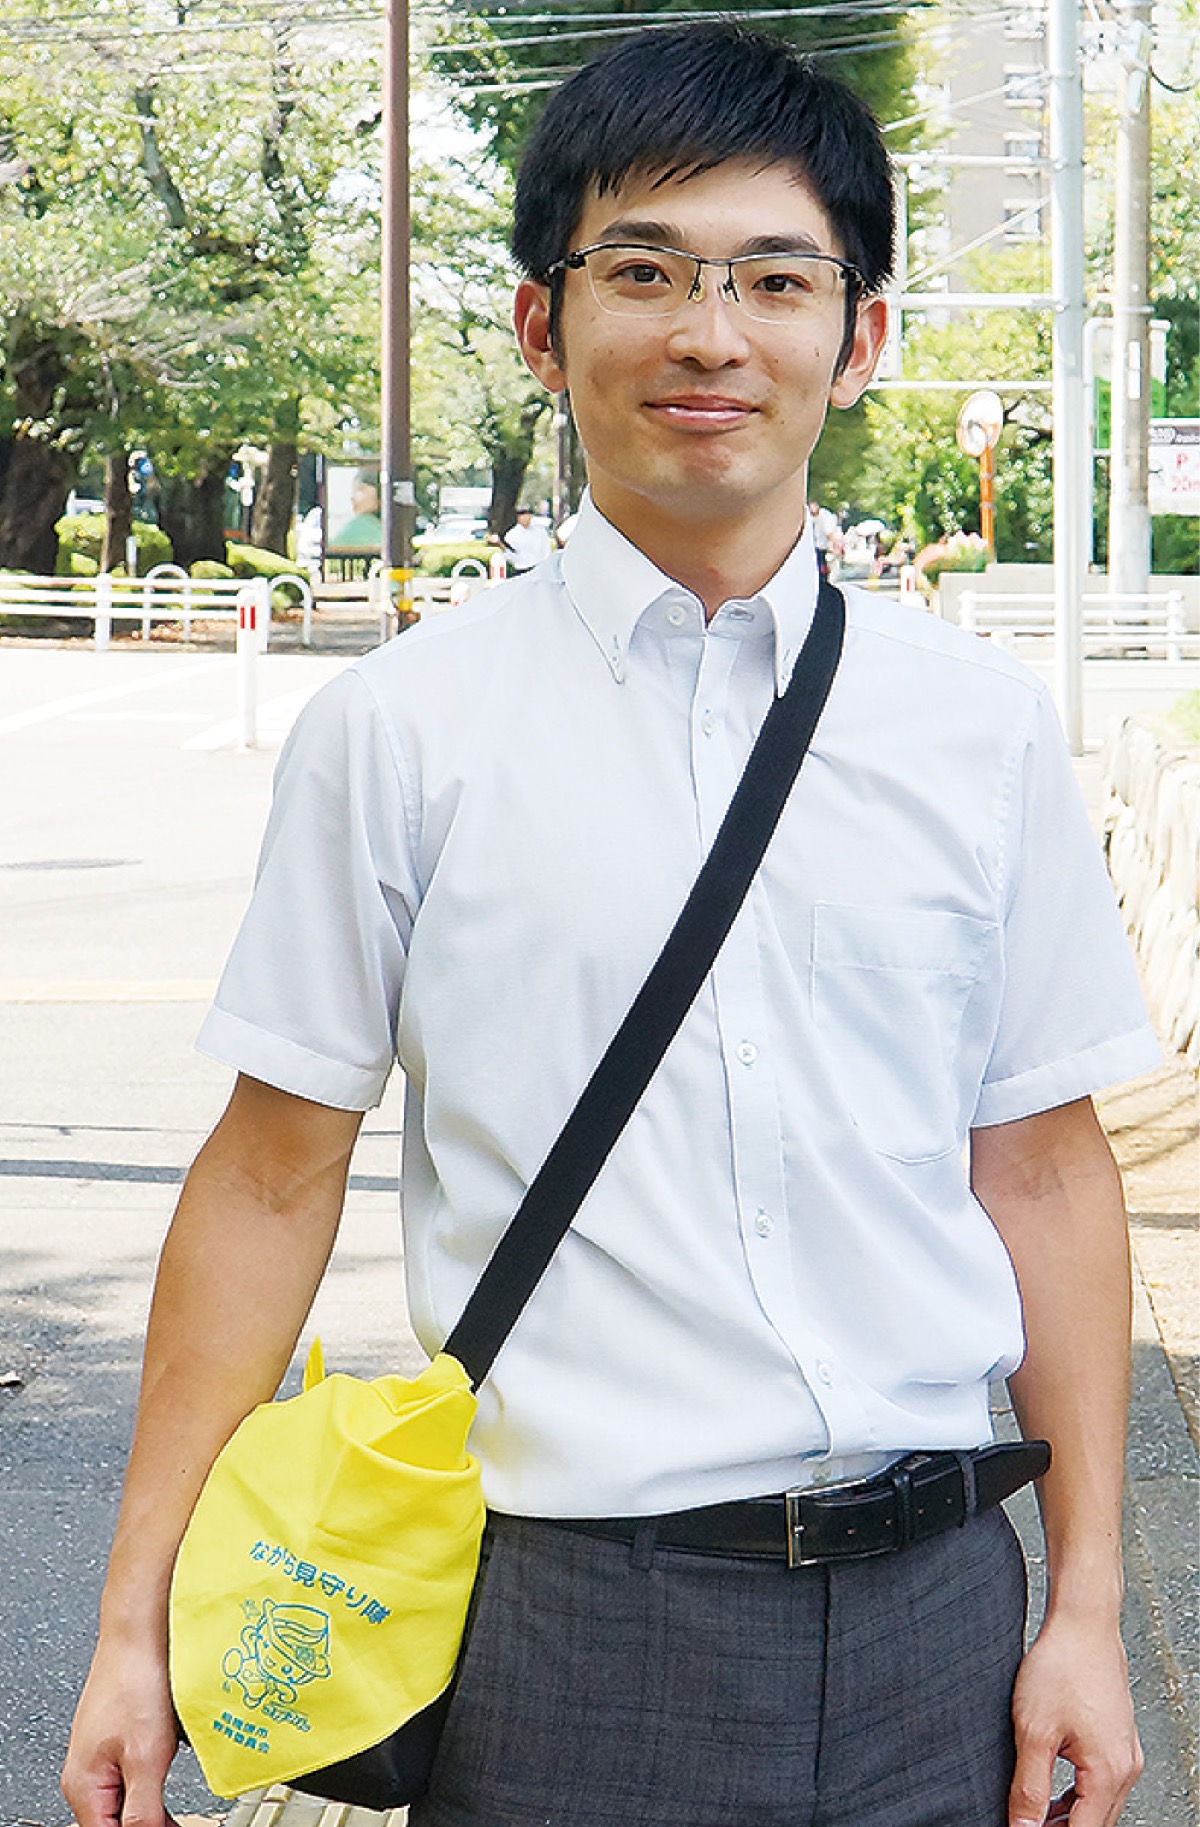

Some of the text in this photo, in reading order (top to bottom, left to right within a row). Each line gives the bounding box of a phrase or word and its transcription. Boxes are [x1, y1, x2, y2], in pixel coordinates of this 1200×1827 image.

[249, 1540, 391, 1624] ながら見守り隊
